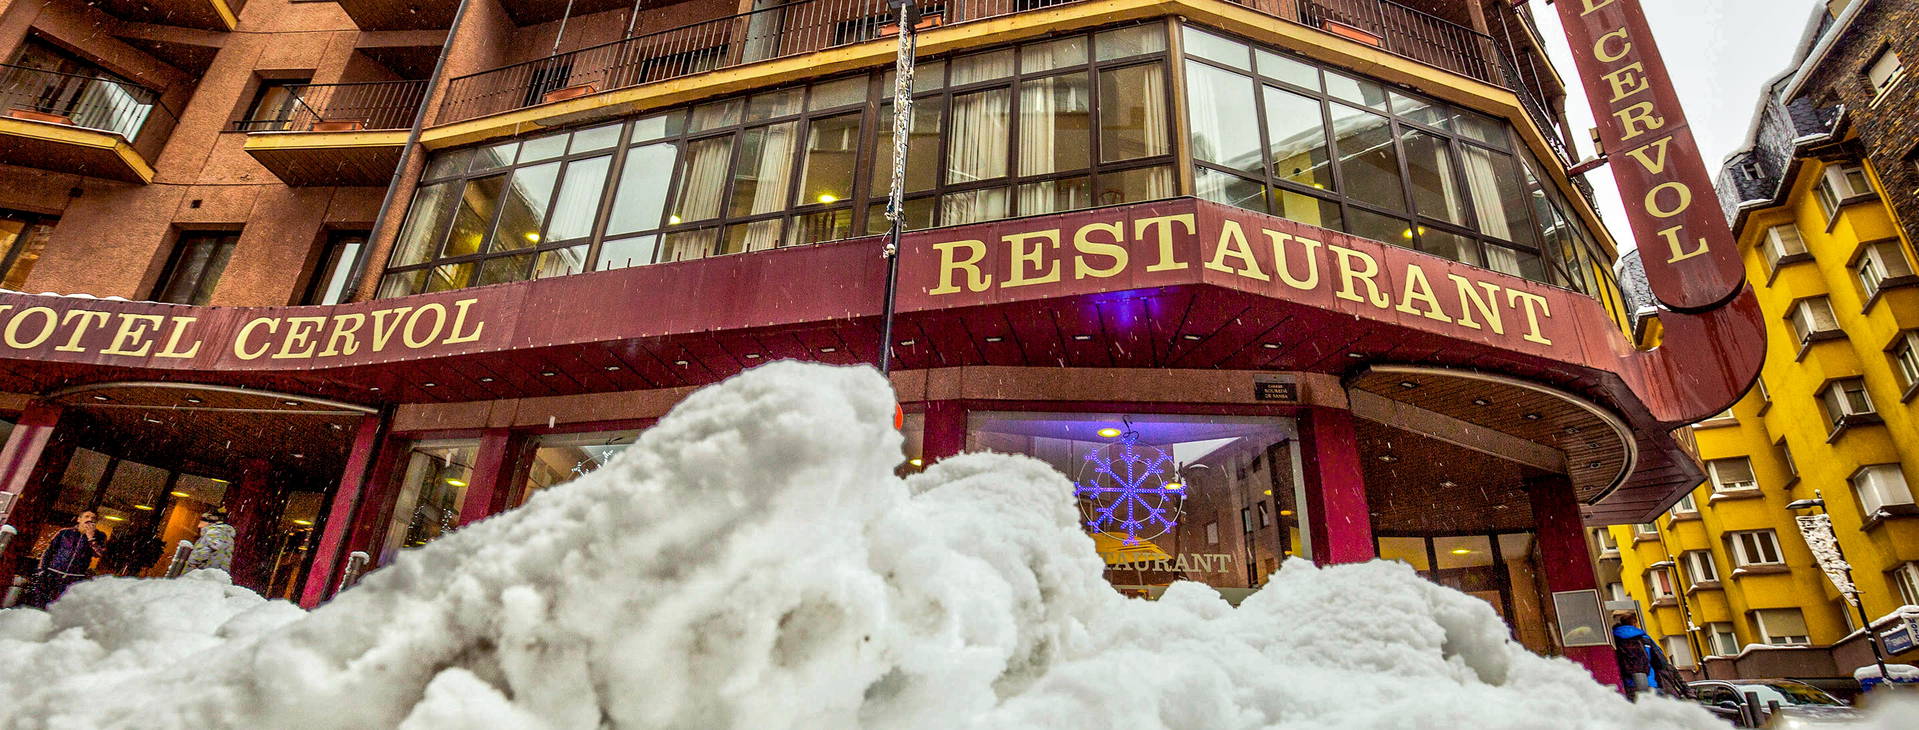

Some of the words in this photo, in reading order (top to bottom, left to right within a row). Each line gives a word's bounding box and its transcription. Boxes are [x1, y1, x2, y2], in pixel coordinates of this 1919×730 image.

[1593, 26, 1710, 265] CERVOL
[929, 212, 1553, 346] RESTAURANT
[232, 298, 486, 361] CERVOL
[1101, 552, 1232, 574] TAURANT
